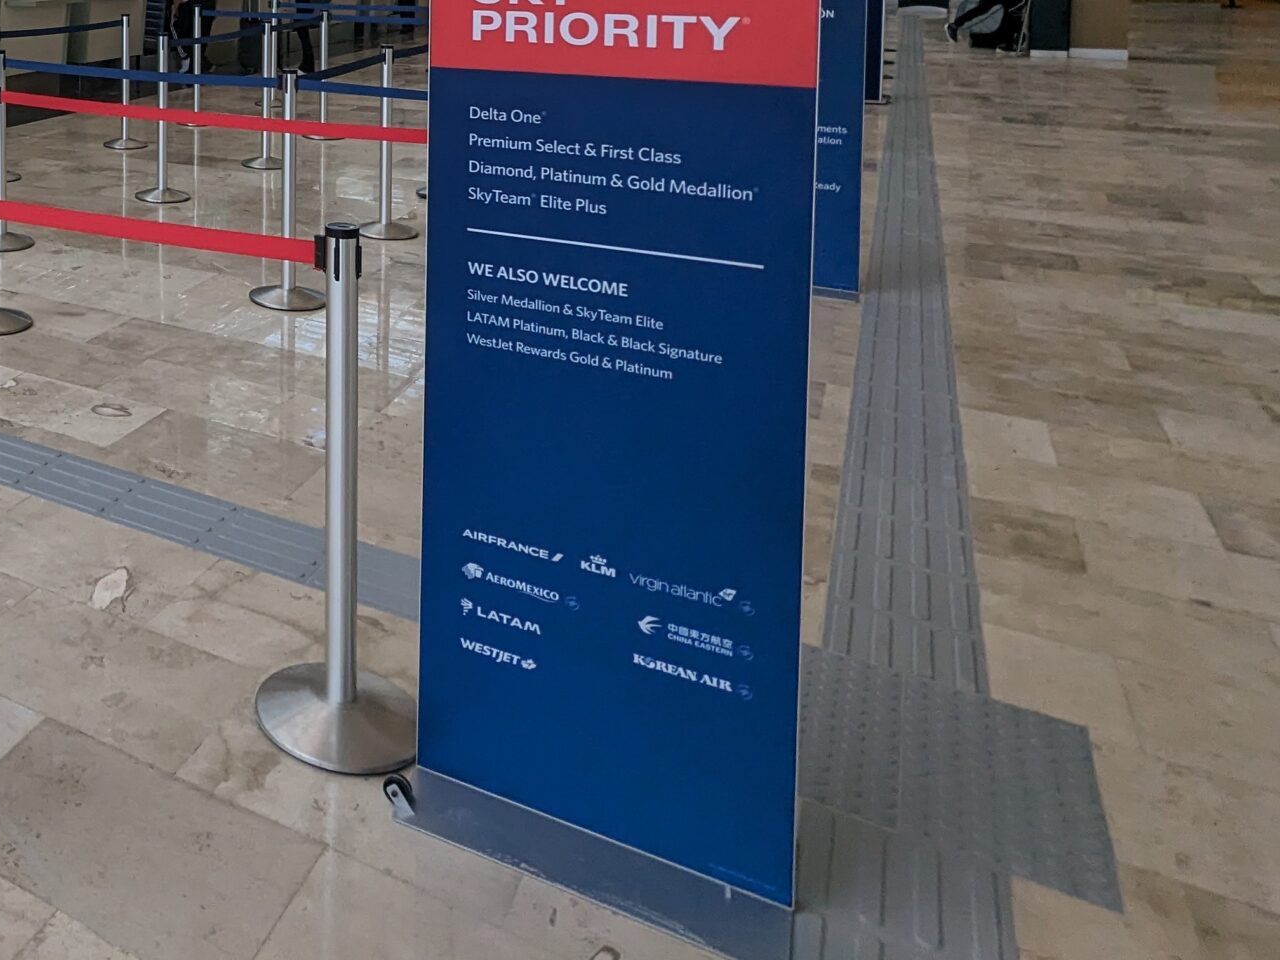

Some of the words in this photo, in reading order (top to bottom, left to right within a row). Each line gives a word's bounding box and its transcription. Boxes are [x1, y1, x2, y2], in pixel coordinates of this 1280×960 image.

[472, 9, 741, 51] PRIORITY
[469, 106, 507, 122] Delta
[511, 110, 542, 124] One
[469, 133, 532, 151] Premium
[536, 139, 581, 156] Select
[584, 143, 597, 157] &
[601, 144, 634, 160] First
[638, 148, 682, 164] Class
[468, 160, 537, 181] Diamond,
[541, 167, 607, 187] Platinum
[610, 174, 623, 188] &
[627, 175, 665, 192] Gold
[669, 179, 753, 201] Medallion
[468, 187, 531, 206] SkyTeam
[540, 195, 572, 211] Elite
[576, 199, 607, 215] Plus
[468, 261, 493, 278] WE
[496, 266, 539, 284] ALSO
[543, 272, 629, 297] WELCOME
[467, 289, 499, 304] Silver
[501, 294, 560, 314] Medallion
[563, 303, 573, 316] &
[576, 306, 633, 325] SkyTeam
[636, 315, 664, 331] Elite
[467, 311, 510, 328] LATAM
[513, 319, 568, 340] Platinum,
[571, 328, 605, 345] Black
[607, 335, 618, 347] &
[621, 336, 655, 354] Black
[658, 343, 723, 364] Signature
[466, 333, 513, 352] WestJet
[516, 342, 567, 361] Rewards
[570, 351, 599, 367] Gold
[601, 357, 612, 370] &
[615, 359, 673, 380] Platinum
[462, 529, 550, 560] AIRFRANCE
[580, 560, 616, 578] KLM
[628, 572, 669, 593] virgin
[670, 584, 722, 607] atlantic
[476, 606, 541, 635] LATAM
[460, 637, 521, 665] WESTJET
[667, 632, 693, 646] CHINA
[694, 638, 733, 657] EASTERN
[632, 653, 698, 682] KOREAN
[699, 674, 733, 692] AIR
